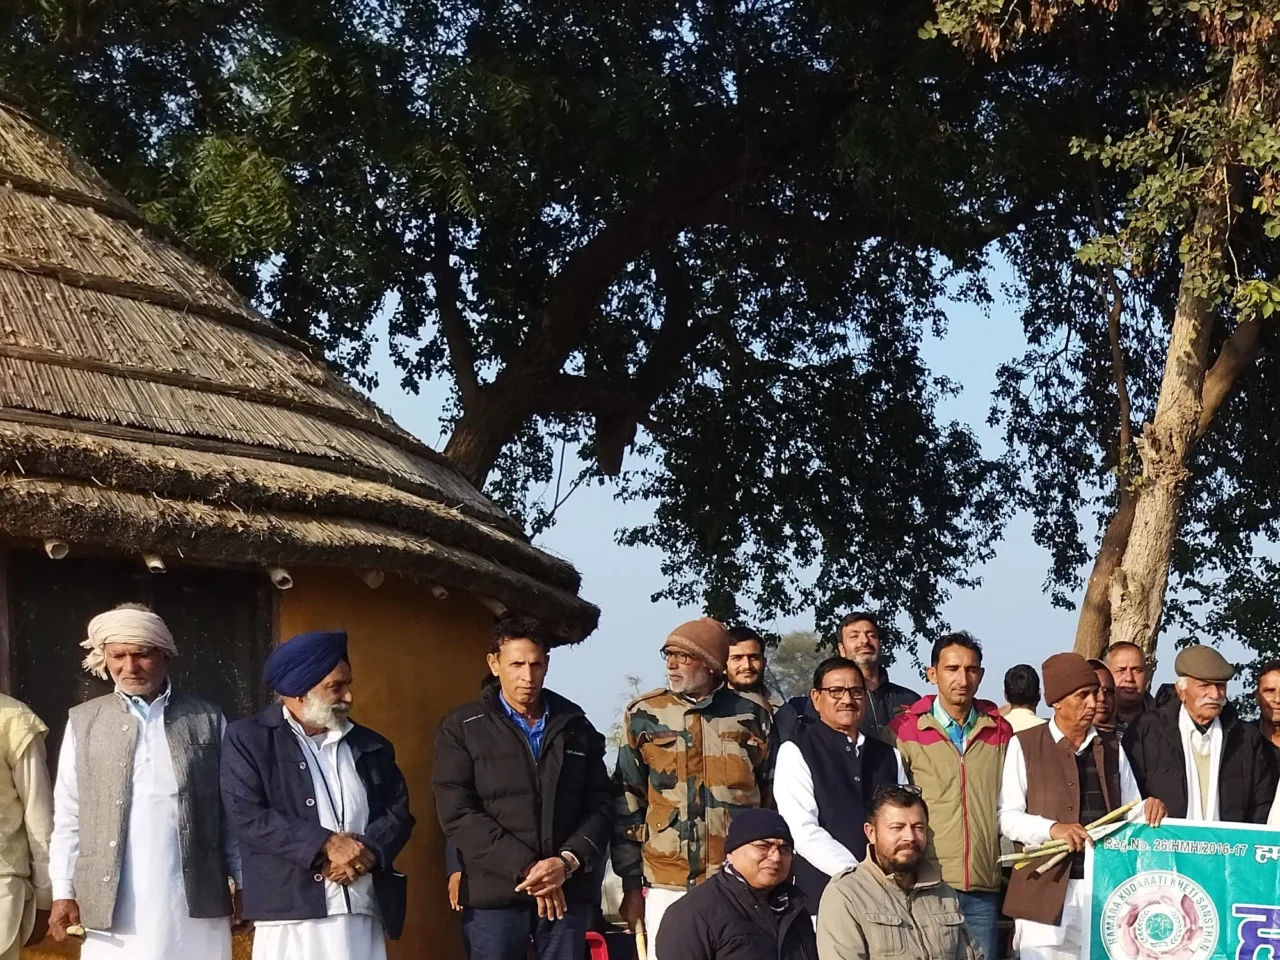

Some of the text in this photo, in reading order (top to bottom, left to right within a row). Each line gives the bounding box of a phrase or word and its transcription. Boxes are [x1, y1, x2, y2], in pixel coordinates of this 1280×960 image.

[1154, 839, 1248, 856] 26/HMH/2016-17
[1106, 902, 1122, 946] HAMARA
[1118, 876, 1167, 901] KUDARATI
[1196, 897, 1214, 953] SANSTHAN
